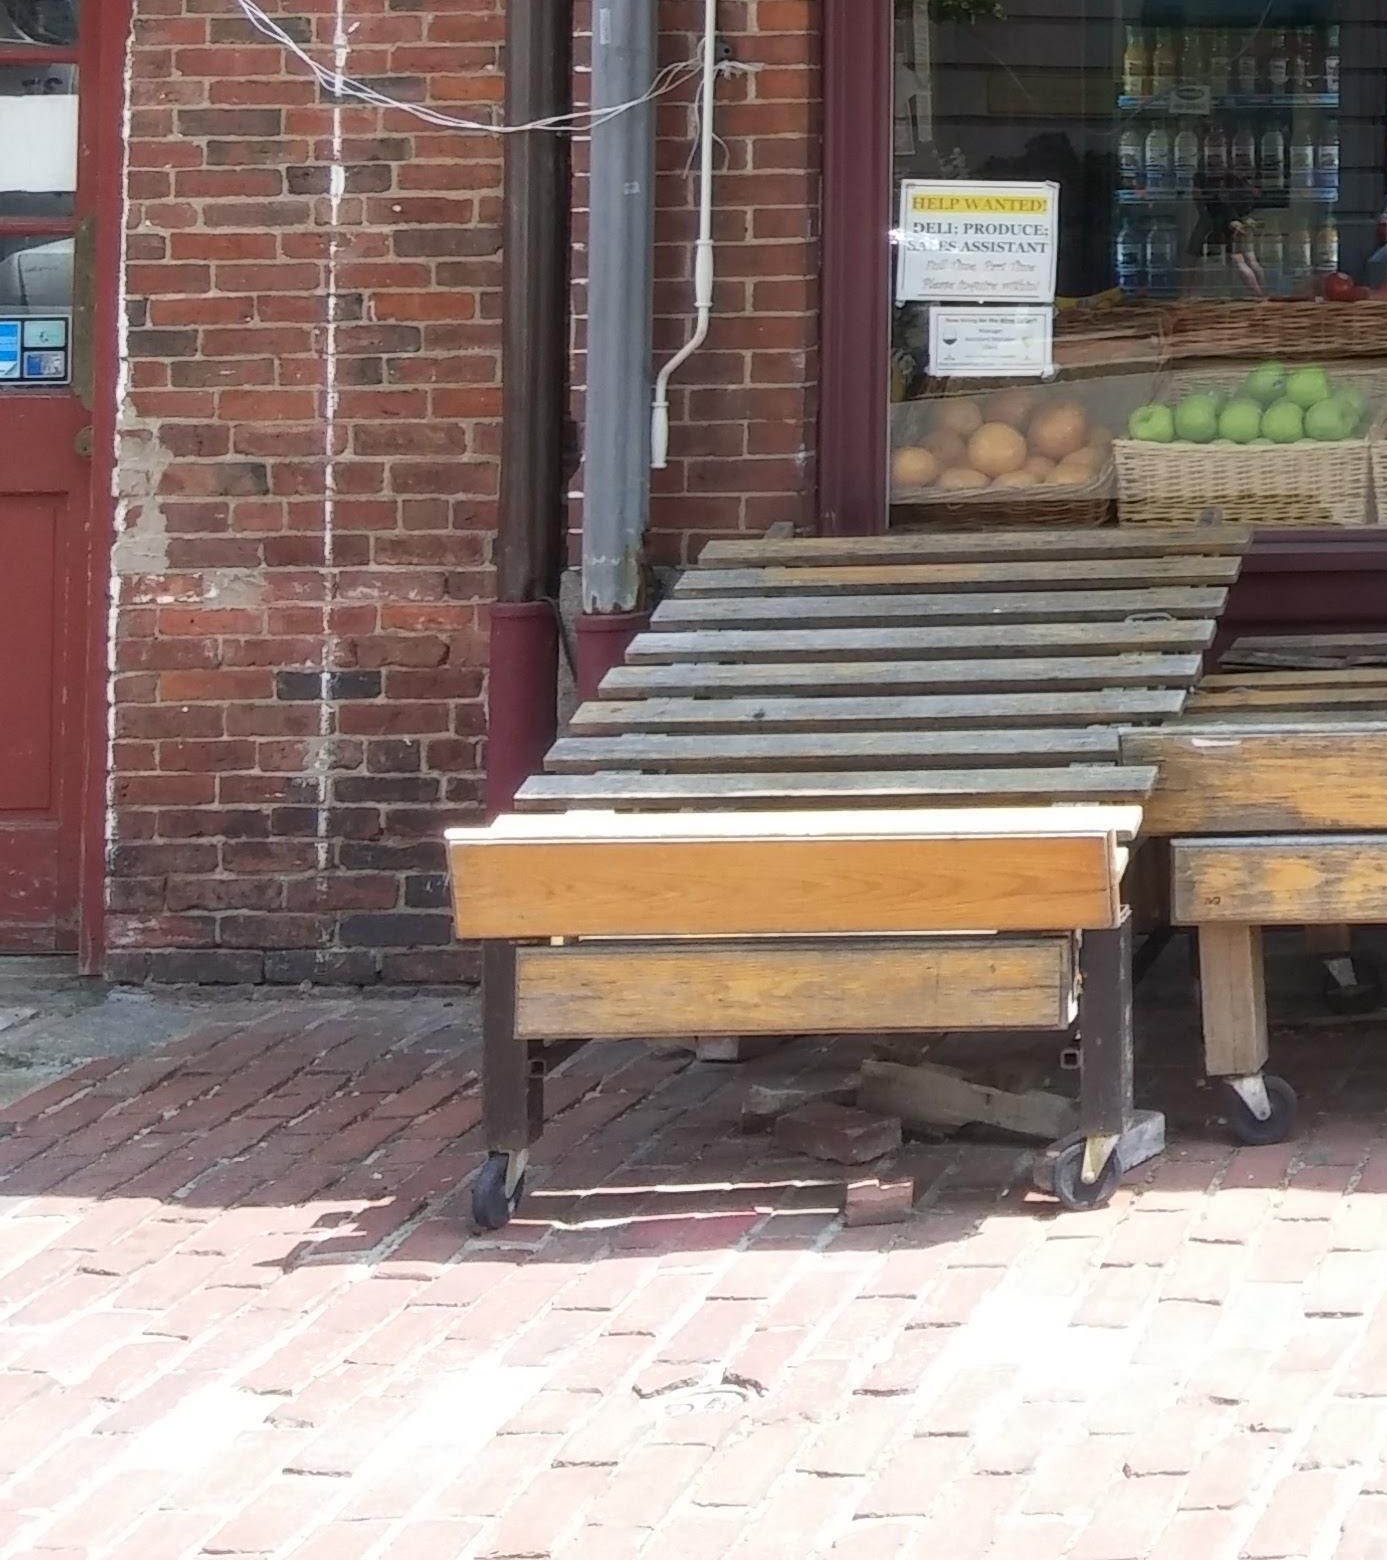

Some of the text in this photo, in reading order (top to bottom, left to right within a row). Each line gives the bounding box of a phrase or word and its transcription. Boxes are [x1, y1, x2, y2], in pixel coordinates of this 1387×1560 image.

[913, 197, 1047, 212] HELP WANTED!
[960, 240, 1048, 253] ASSISTANT
